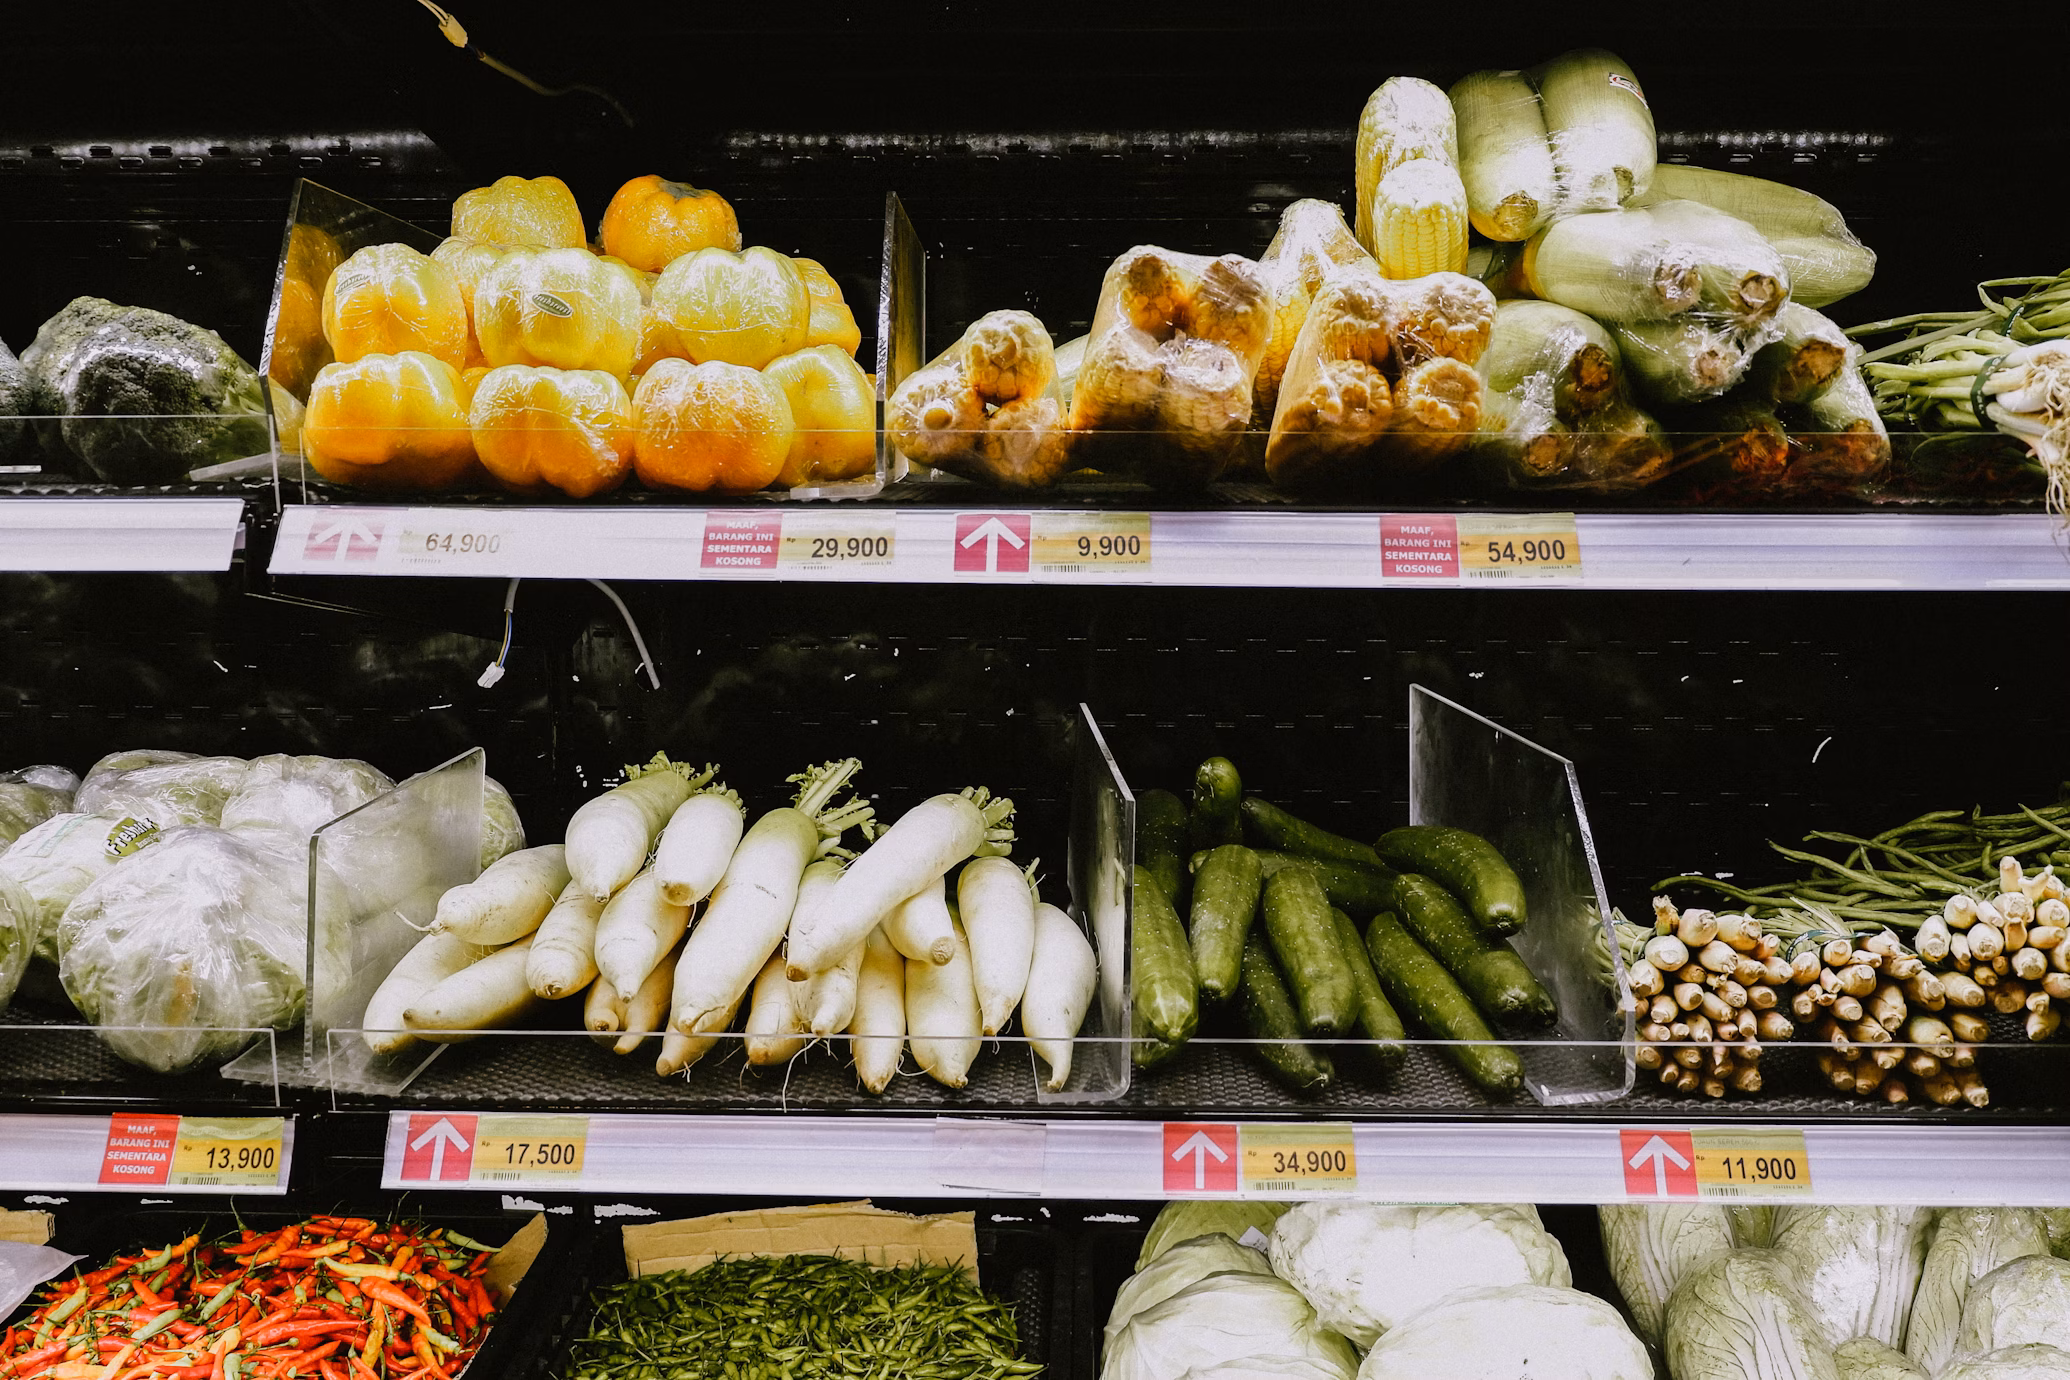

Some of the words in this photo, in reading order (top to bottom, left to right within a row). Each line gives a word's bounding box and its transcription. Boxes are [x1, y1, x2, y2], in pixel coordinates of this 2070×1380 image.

[726, 521, 759, 530] MAAF,
[1400, 526, 1434, 536] MAAF,
[708, 533, 753, 541] BARANG
[756, 533, 774, 541] INI
[425, 533, 500, 555] 64,900
[1078, 535, 1140, 559] 9,900
[1384, 538, 1430, 548] BARANG
[1433, 539, 1451, 548] INI
[707, 545, 772, 553] SEMENTARA
[811, 537, 888, 560] 29,900
[1488, 540, 1565, 564] 54,900
[715, 557, 761, 566] KOSONG
[1385, 552, 1452, 561] SEMENTARA
[1395, 564, 1442, 574] KOSONG
[127, 1125, 157, 1135] MAAF,
[109, 1138, 151, 1147] BARANG
[153, 1139, 170, 1148] INI
[107, 1151, 167, 1161] SEMENTARA
[206, 1147, 274, 1171] 13,900
[505, 1143, 575, 1167] 17,500
[1273, 1150, 1346, 1175] 34,900
[113, 1165, 155, 1174] KOSONG
[1722, 1157, 1796, 1182] 11,900
